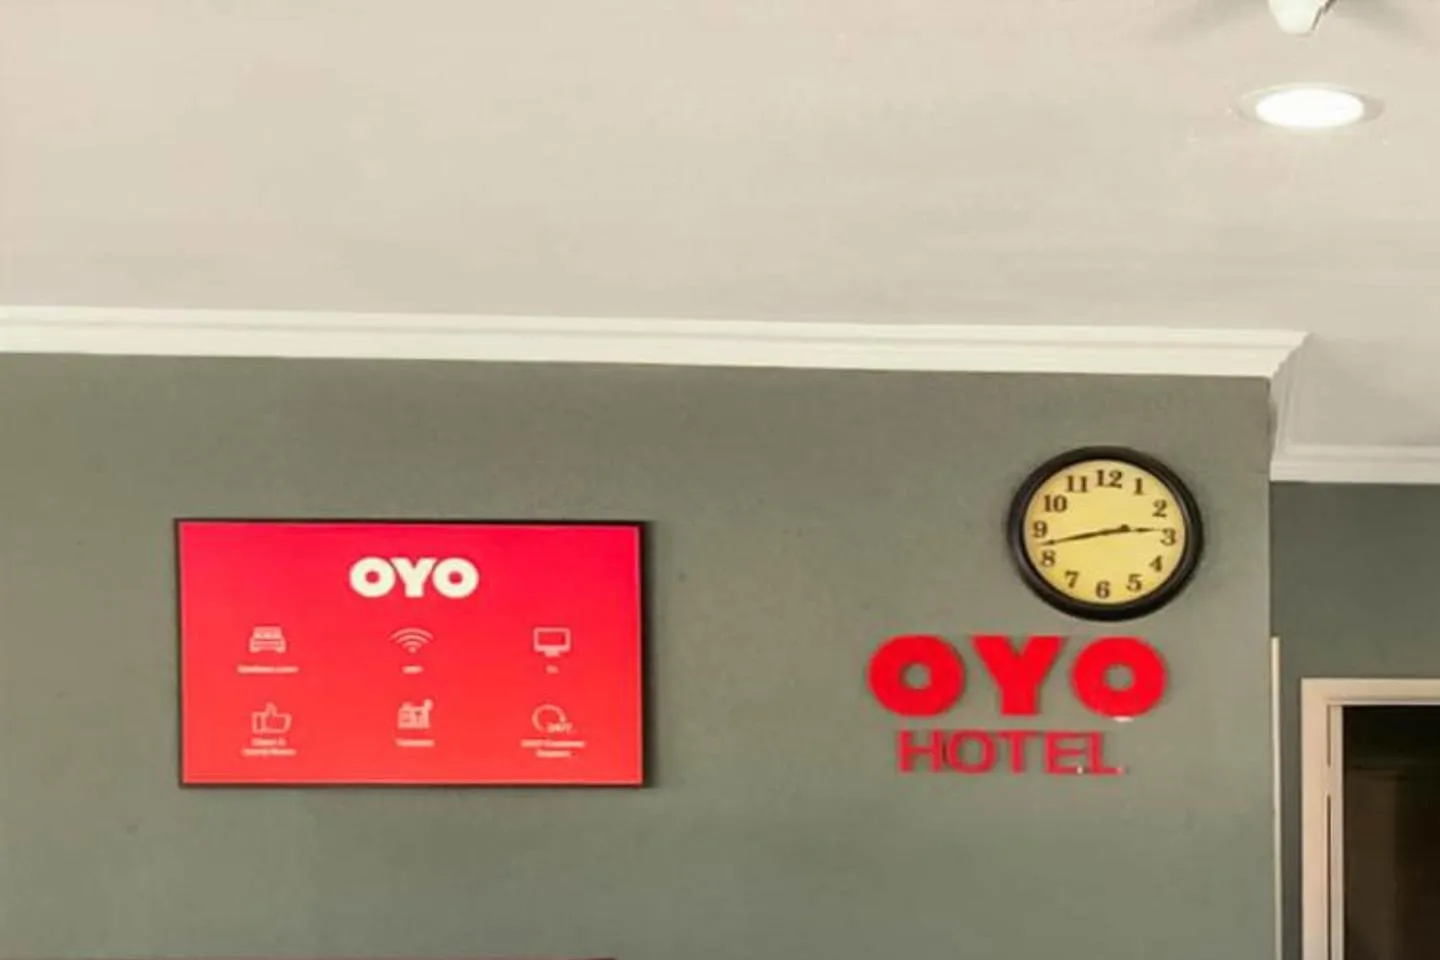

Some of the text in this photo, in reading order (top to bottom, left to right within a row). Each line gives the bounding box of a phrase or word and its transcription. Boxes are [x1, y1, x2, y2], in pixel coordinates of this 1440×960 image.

[1066, 475, 1088, 493] 11
[1095, 469, 1123, 488] 12
[1133, 477, 1144, 495] 1
[1044, 495, 1068, 513] 10
[1152, 500, 1167, 517] 2
[1032, 520, 1048, 538] 9
[1160, 528, 1176, 546] 3
[1041, 550, 1056, 567] 8
[1149, 555, 1163, 572] 4
[349, 556, 480, 599] OYO
[1065, 570, 1079, 588] 7
[1126, 574, 1142, 591] 5
[1095, 580, 1110, 599] 6
[867, 633, 1168, 719] OYO
[896, 729, 1127, 775] HOTEL
